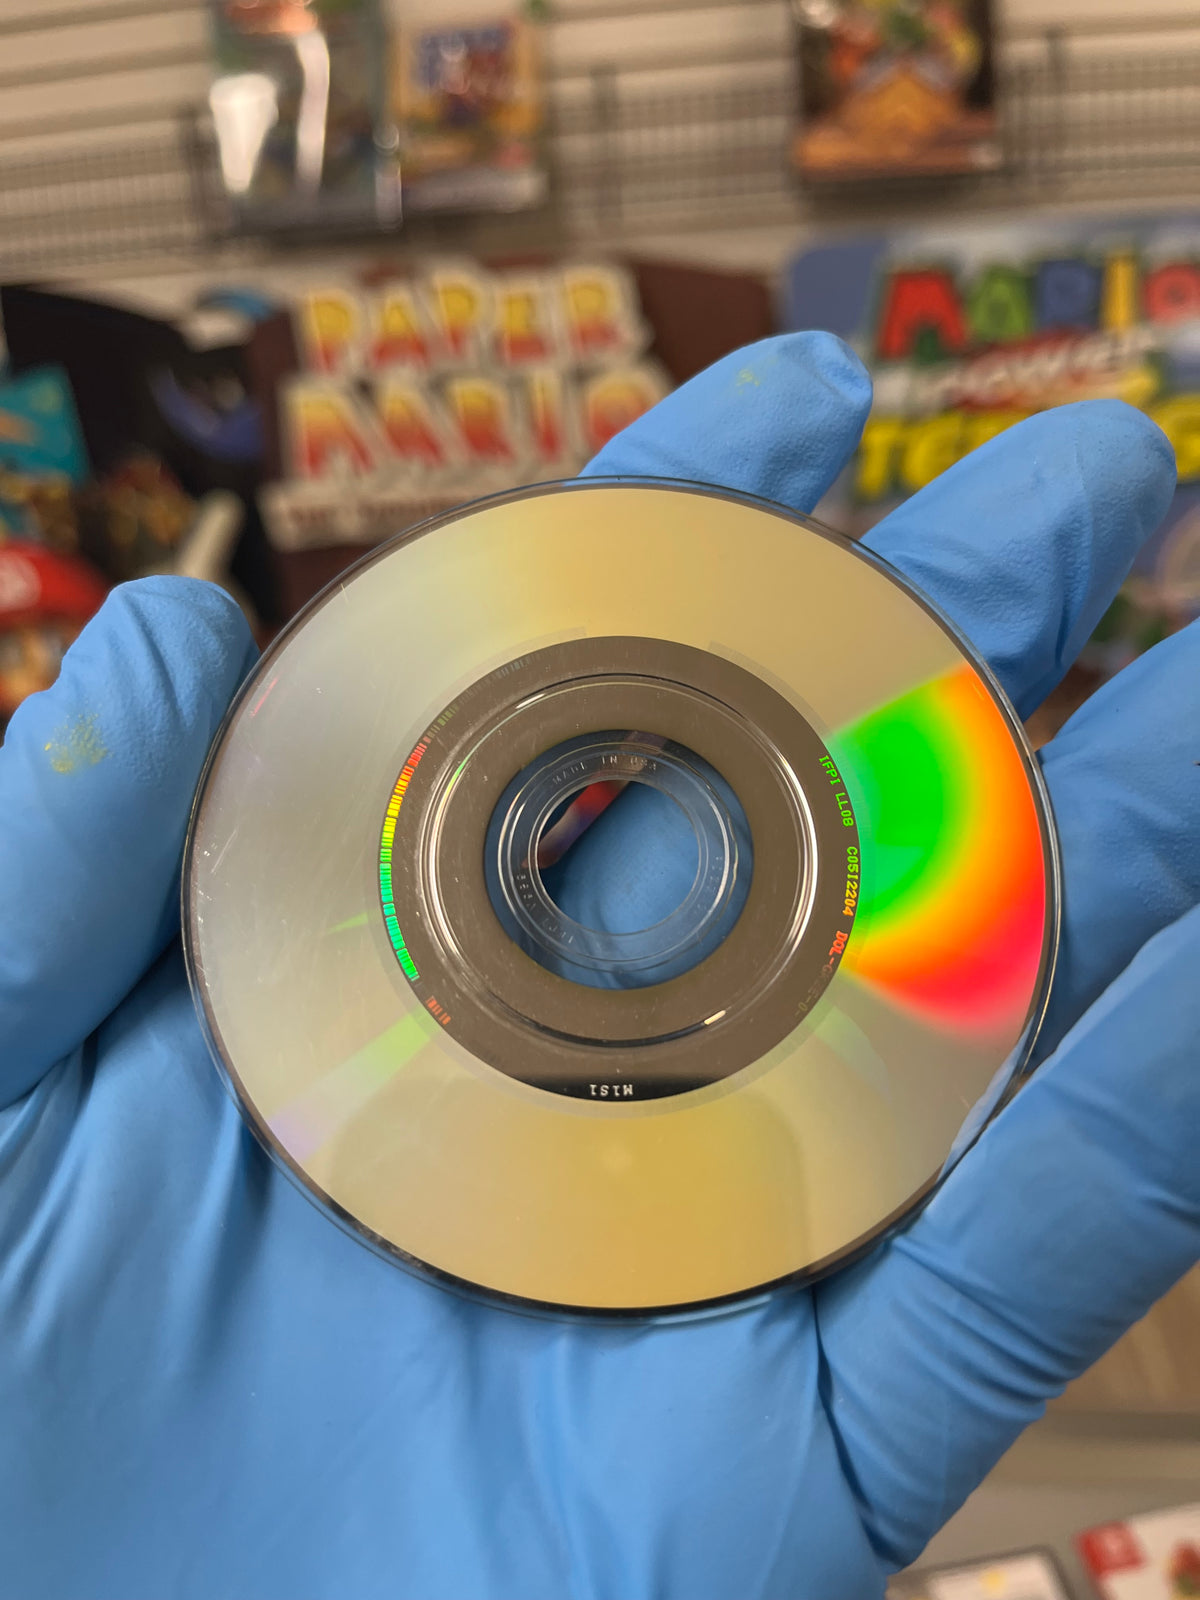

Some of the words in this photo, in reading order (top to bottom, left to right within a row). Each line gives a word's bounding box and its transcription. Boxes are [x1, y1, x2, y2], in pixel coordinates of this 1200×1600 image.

[300, 268, 630, 378] PAPER
[600, 754, 618, 764] IN
[818, 754, 841, 785] IFPI
